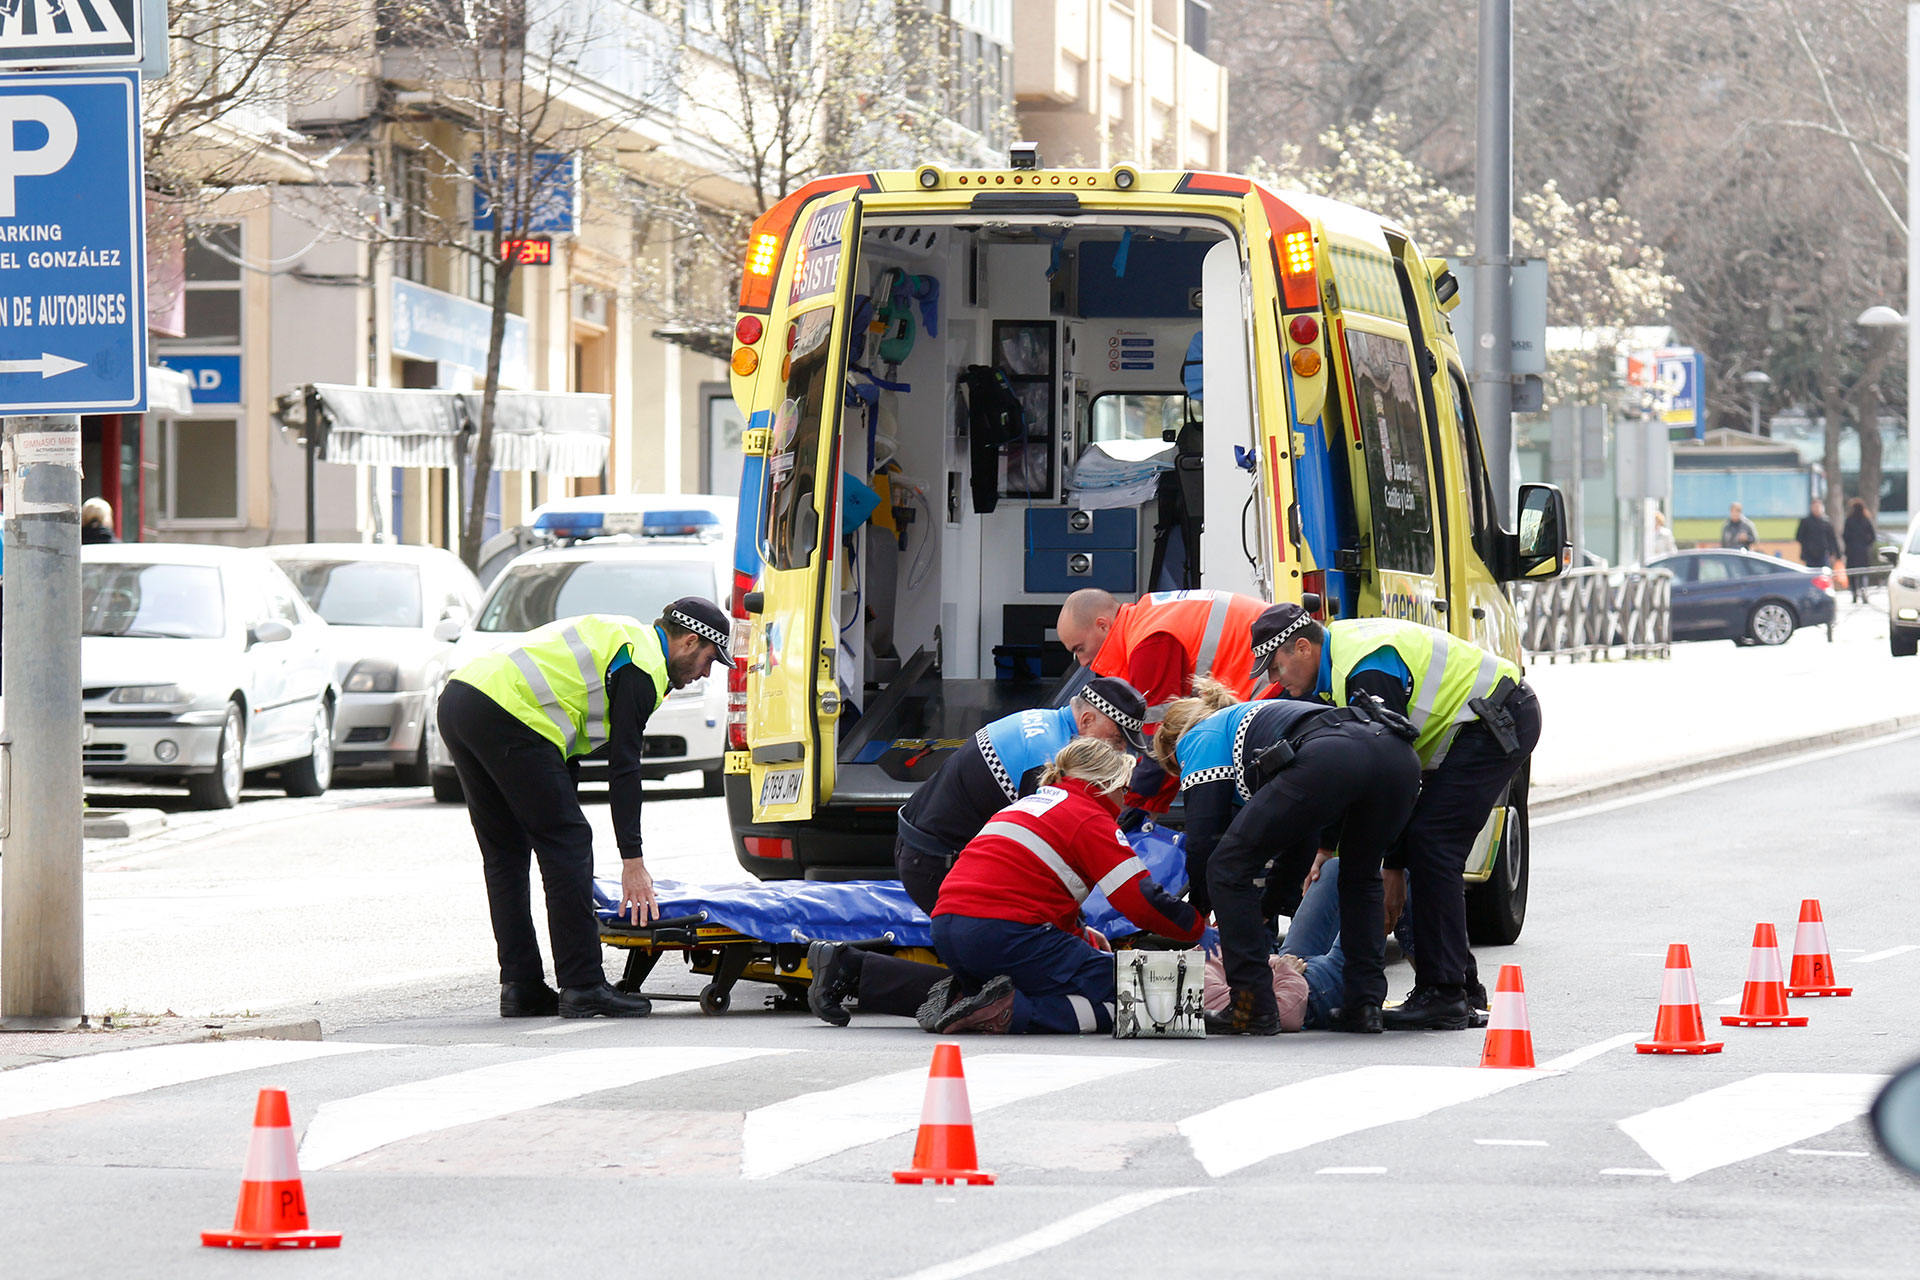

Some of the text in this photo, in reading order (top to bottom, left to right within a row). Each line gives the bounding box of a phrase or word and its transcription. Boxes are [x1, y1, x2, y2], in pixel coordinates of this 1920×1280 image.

[0, 245, 121, 269] EL GONZÁLEZ
[13, 295, 33, 327] DE
[38, 292, 126, 326] AUTOBUSES
